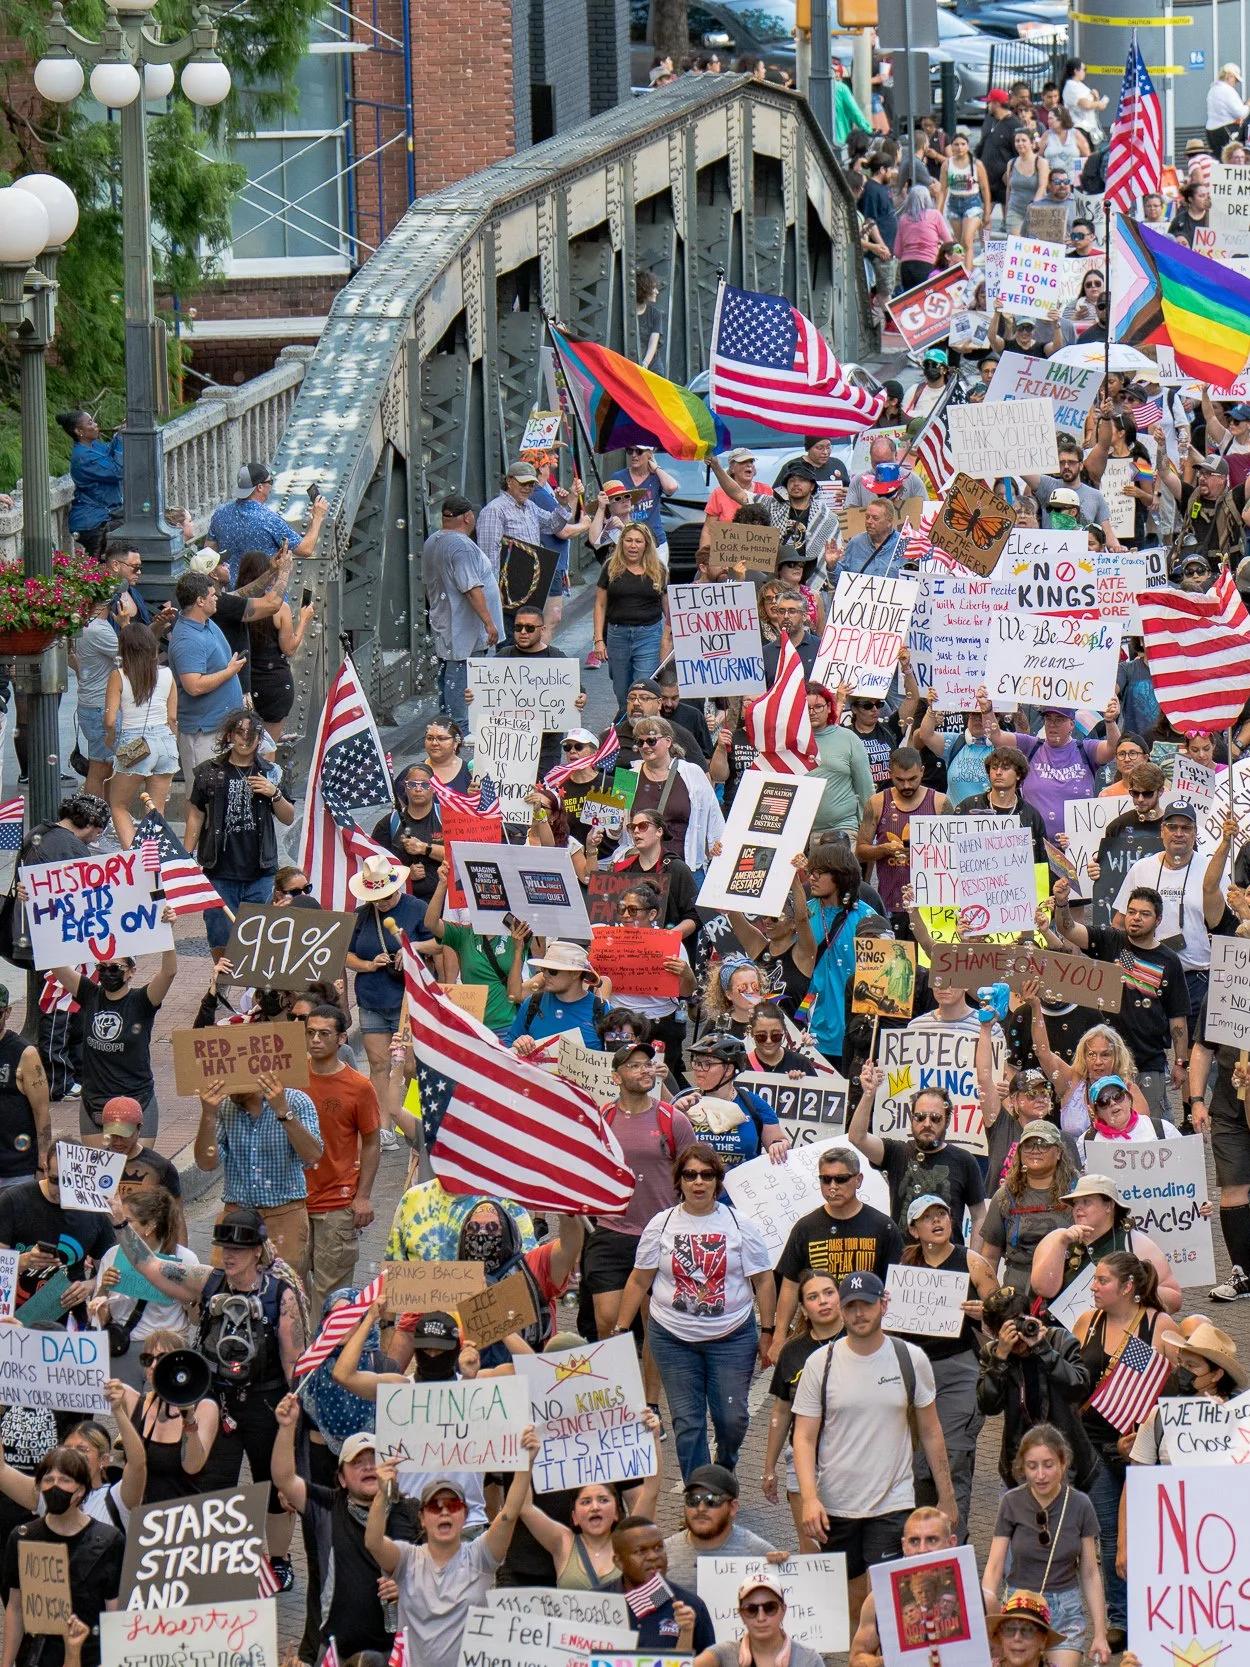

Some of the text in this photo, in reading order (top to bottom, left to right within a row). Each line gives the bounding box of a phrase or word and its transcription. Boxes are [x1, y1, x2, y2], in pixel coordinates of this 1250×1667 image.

[1127, 18, 1150, 26] CAUTION
[1101, 66, 1123, 74] CAUTION
[1212, 183, 1235, 198] THE
[1014, 241, 1059, 258] HUMAN
[1008, 255, 1058, 274] RIGHTS
[1006, 270, 1057, 289] BELONG
[1019, 284, 1035, 296] TO
[998, 292, 1054, 311] EVERYONE
[1017, 356, 1095, 388] I HAVE
[1014, 377, 1081, 402] FRIENDS
[956, 473, 1010, 516] FIGHT FOR
[955, 533, 979, 552] THE
[932, 532, 987, 578] DREAMERS
[673, 584, 742, 610] FIGHT
[672, 608, 757, 638] IGNORANCE
[700, 633, 736, 654] NOT
[676, 656, 765, 687] IMMIGRANTS
[774, 790, 793, 798] NATION
[753, 820, 782, 829] DISTRESS
[760, 814, 780, 822] UNDER
[742, 848, 757, 859] ICE
[31, 853, 136, 896] HISTORY
[733, 870, 767, 880] AMERICAN
[729, 879, 763, 890] GESTAPO
[34, 885, 114, 925] HAS ITS
[62, 903, 157, 943] EYES ON
[88, 934, 116, 960] U
[237, 914, 340, 973] 99%
[855, 939, 874, 951] NO
[856, 951, 886, 965] KINGS
[940, 951, 1102, 992] SHAME ON YOU
[67, 1145, 114, 1168] HISTORY
[71, 1162, 97, 1176] HAS ITS
[76, 1174, 96, 1192] EYES
[828, 1237, 876, 1251] RAISE YOUR VOICE!
[828, 1251, 876, 1273] SPEAK OUT!
[893, 1270, 914, 1288] NO
[918, 1270, 947, 1289] ONE
[903, 1291, 951, 1308] ILLEGAL
[917, 1305, 935, 1316] ON
[886, 1316, 958, 1333] STOLEN LAND
[386, 1384, 507, 1426] CHINGA
[436, 1423, 468, 1440] TU
[421, 1433, 518, 1467] MAGA!!!
[138, 1495, 254, 1547] STARS.
[1157, 1480, 1236, 1575] NO
[127, 1580, 190, 1612] AND
